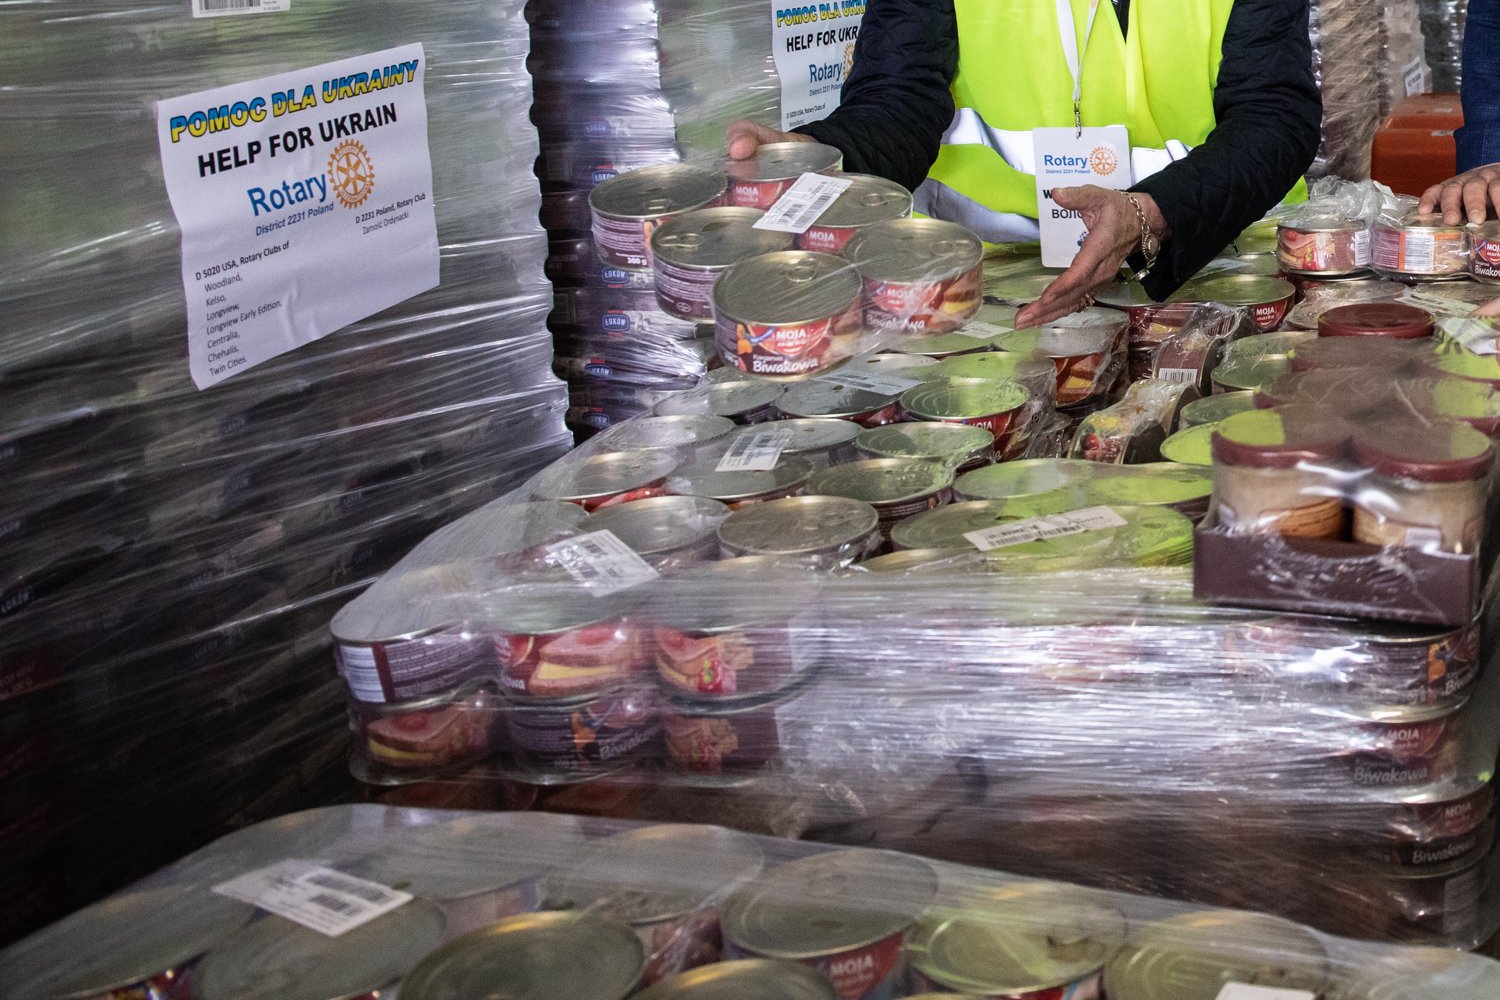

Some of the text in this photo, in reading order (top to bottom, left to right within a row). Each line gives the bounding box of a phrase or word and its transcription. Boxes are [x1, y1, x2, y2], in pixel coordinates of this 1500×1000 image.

[776, 4, 817, 27] POMOC
[819, 2, 841, 21] DLA
[786, 26, 860, 53] HELP FOR UKR
[809, 62, 843, 83] Rotary
[170, 60, 419, 143] POMOC DLA UKRAINY
[198, 103, 397, 177] HELP FOR UKRAIN
[1044, 155, 1087, 168] Rotary
[247, 173, 326, 216] Rotary
[735, 186, 759, 196] MOJA
[361, 211, 375, 222] 2231
[376, 204, 396, 217] Poland,
[397, 198, 414, 209] Rotary
[414, 192, 426, 202] Club
[255, 203, 334, 236] District 2231 Poland
[809, 231, 835, 241] MOJA
[196, 241, 290, 281] D 5020 USA, Rotary Clubs of
[204, 273, 243, 292] Woodland,
[206, 318, 239, 335] Longview
[240, 308, 256, 323] Early
[604, 315, 626, 326] ŁUKÓW
[1256, 306, 1275, 316] MOJA
[776, 329, 806, 340] MOJA
[210, 364, 227, 377] Twin
[753, 358, 818, 373] Biwakowa
[972, 421, 992, 430] OJA
[830, 954, 873, 978] MOJA
